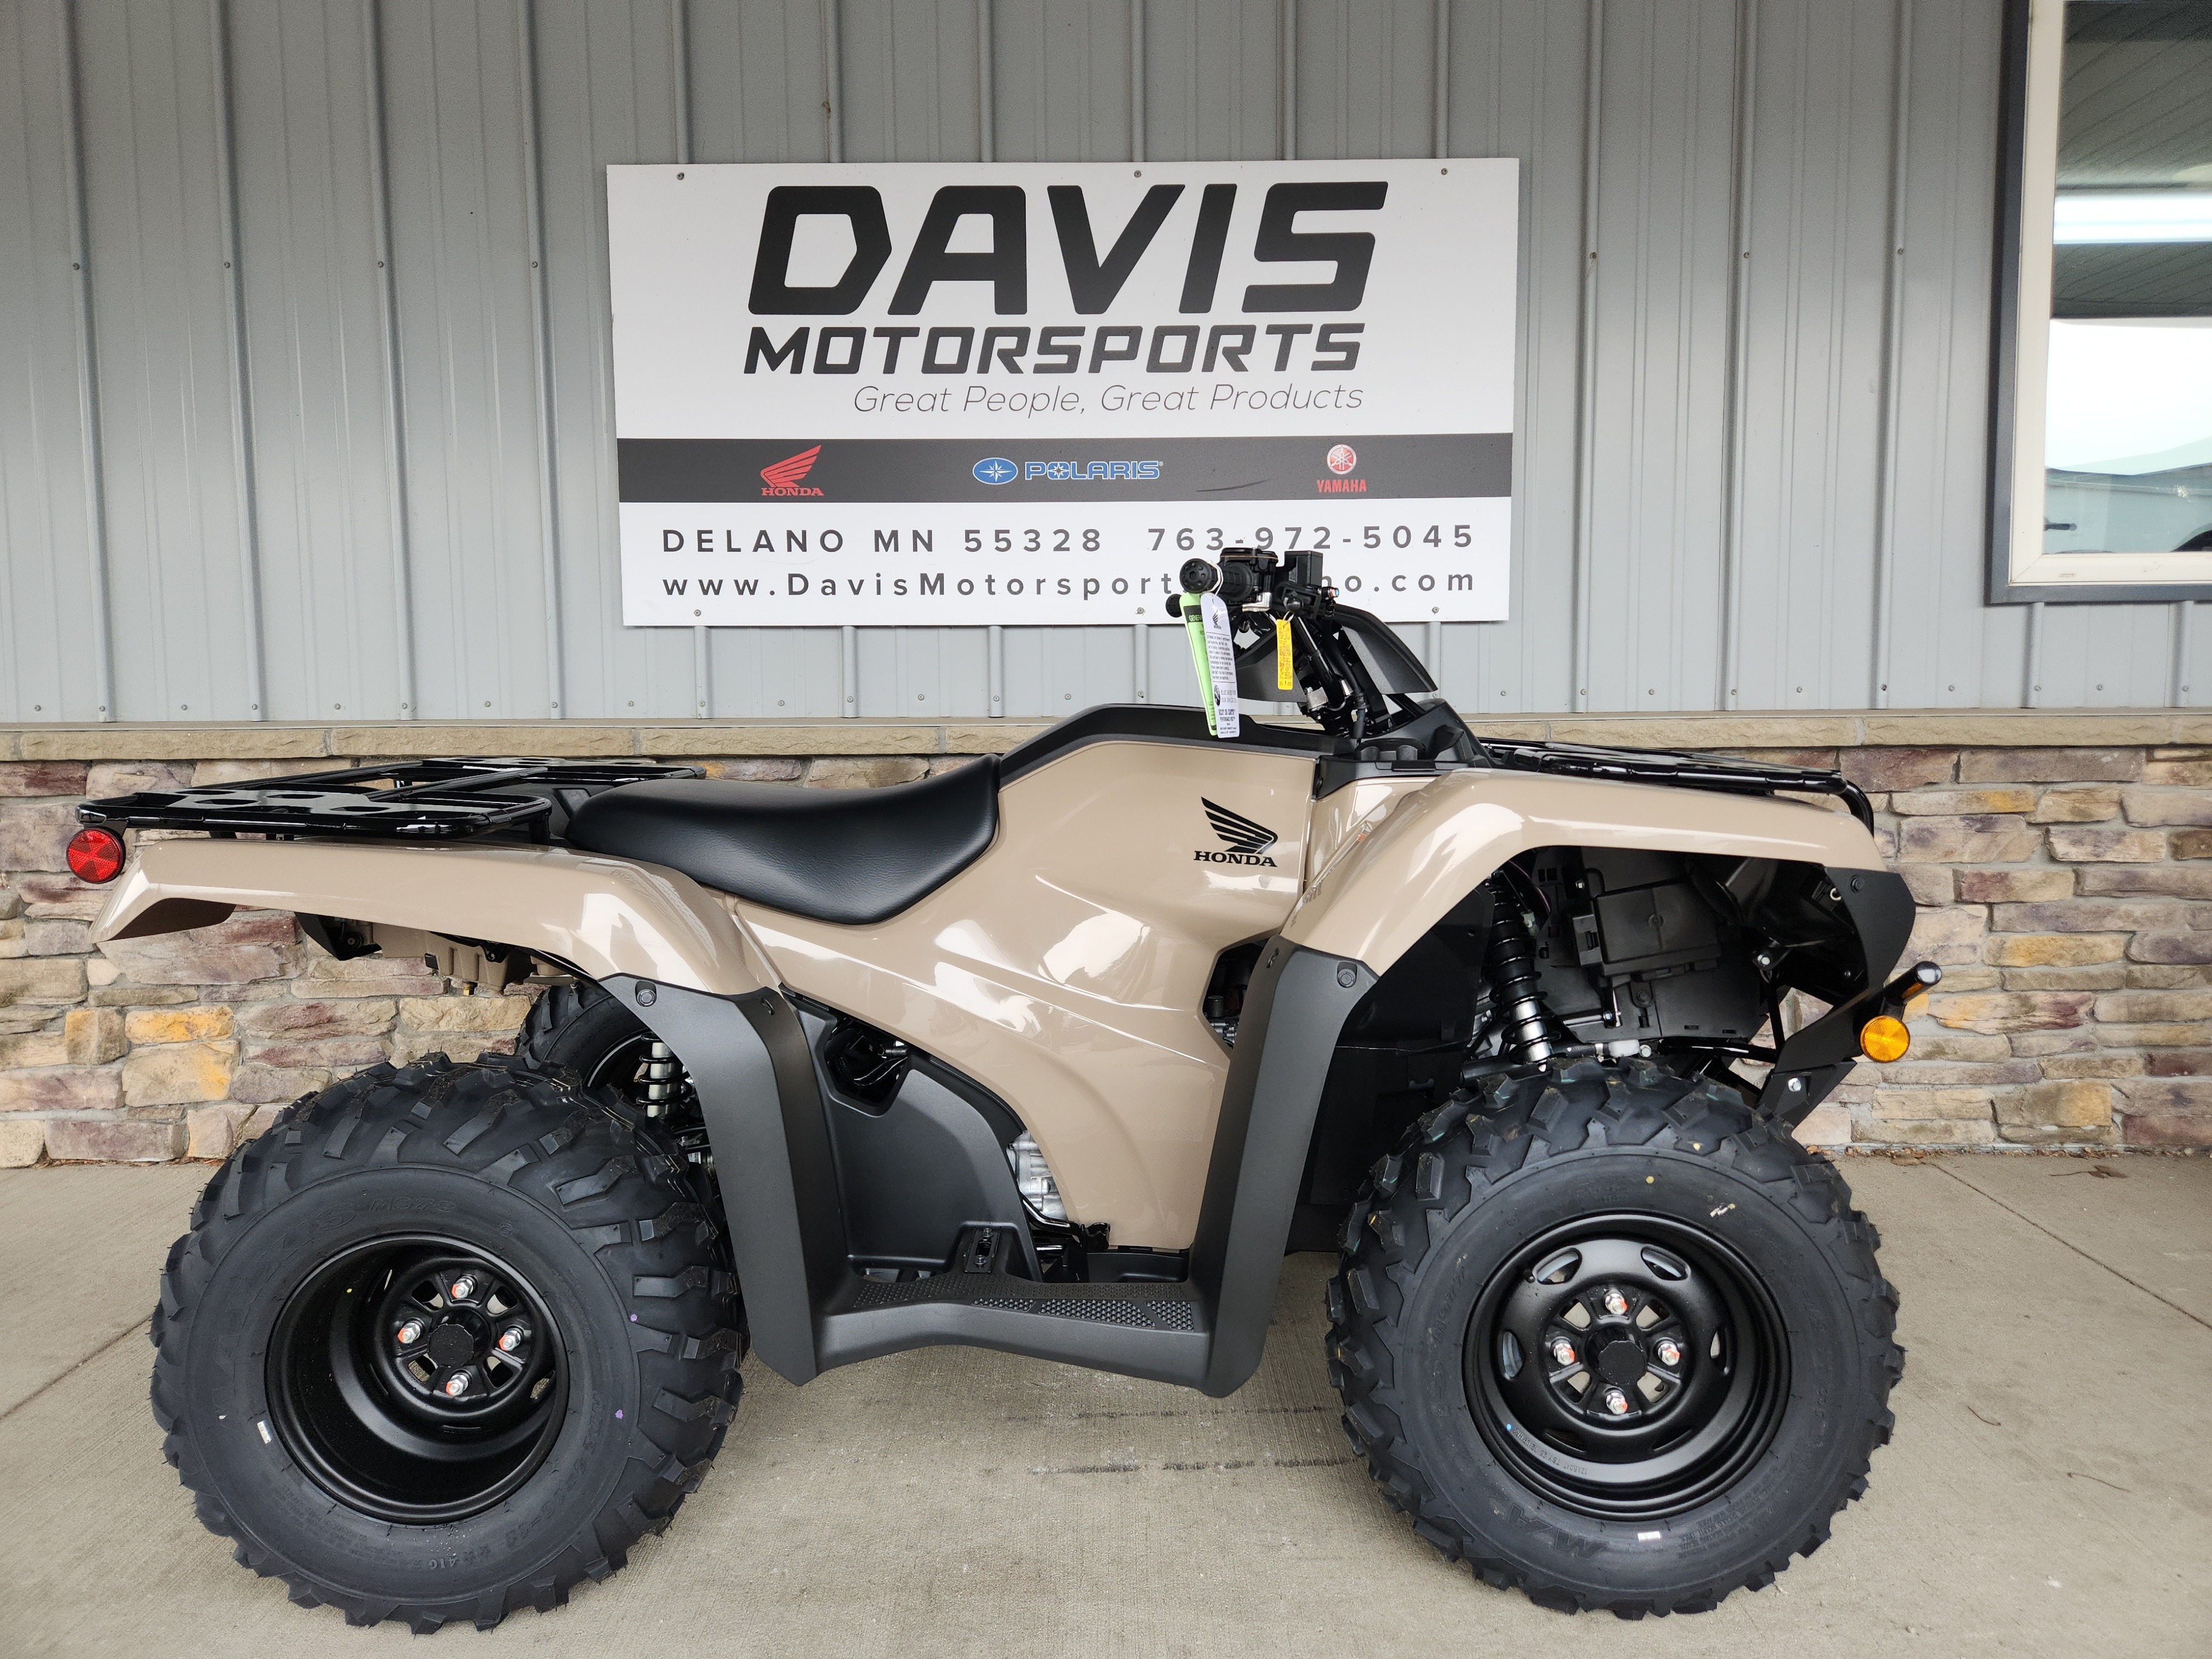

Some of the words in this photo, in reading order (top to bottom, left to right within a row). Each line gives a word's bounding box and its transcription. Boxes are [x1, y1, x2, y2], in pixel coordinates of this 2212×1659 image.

[748, 181, 1388, 315] DAVIS
[744, 323, 1365, 374] MOTORSPORTS
[854, 385, 952, 412] Great
[963, 385, 1085, 419] People,
[1102, 384, 1199, 411] Great
[1210, 383, 1364, 410] Products
[1025, 461, 1160, 480] POLARIS
[761, 487, 824, 496] HONDA
[1317, 479, 1367, 493] YAMAHA
[662, 529, 843, 552] DELANO
[874, 529, 933, 552] MN
[964, 529, 1100, 552] 55328
[1148, 524, 1472, 551] 763-972-5045
[662, 572, 1473, 601] www.DavisMotorsporto.com
[1193, 851, 1277, 867] HONDA
